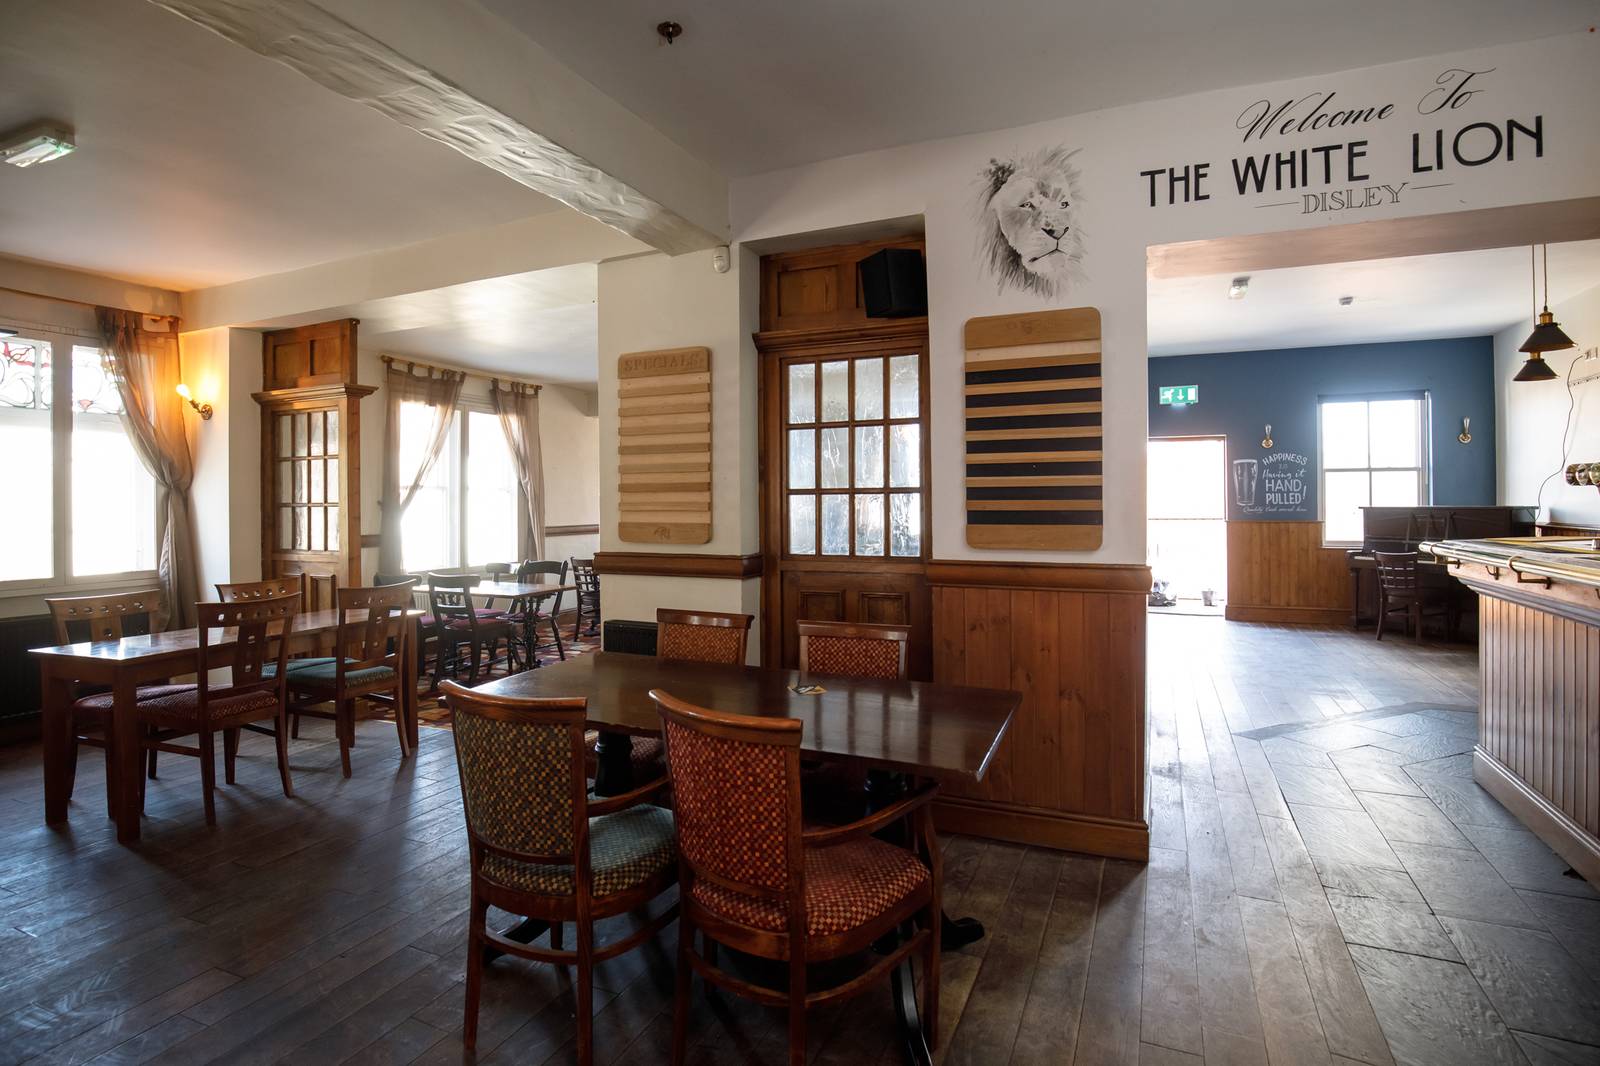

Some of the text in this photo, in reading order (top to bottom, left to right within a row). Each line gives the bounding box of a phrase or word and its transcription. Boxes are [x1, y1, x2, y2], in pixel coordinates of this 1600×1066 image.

[1235, 67, 1496, 143] Welcome To
[1140, 115, 1544, 207] THE WHITE LION
[1301, 182, 1409, 214] DISLEY
[1262, 453, 1308, 466] HAPPINESS
[1295, 469, 1307, 478] it
[1265, 479, 1302, 492] HAND
